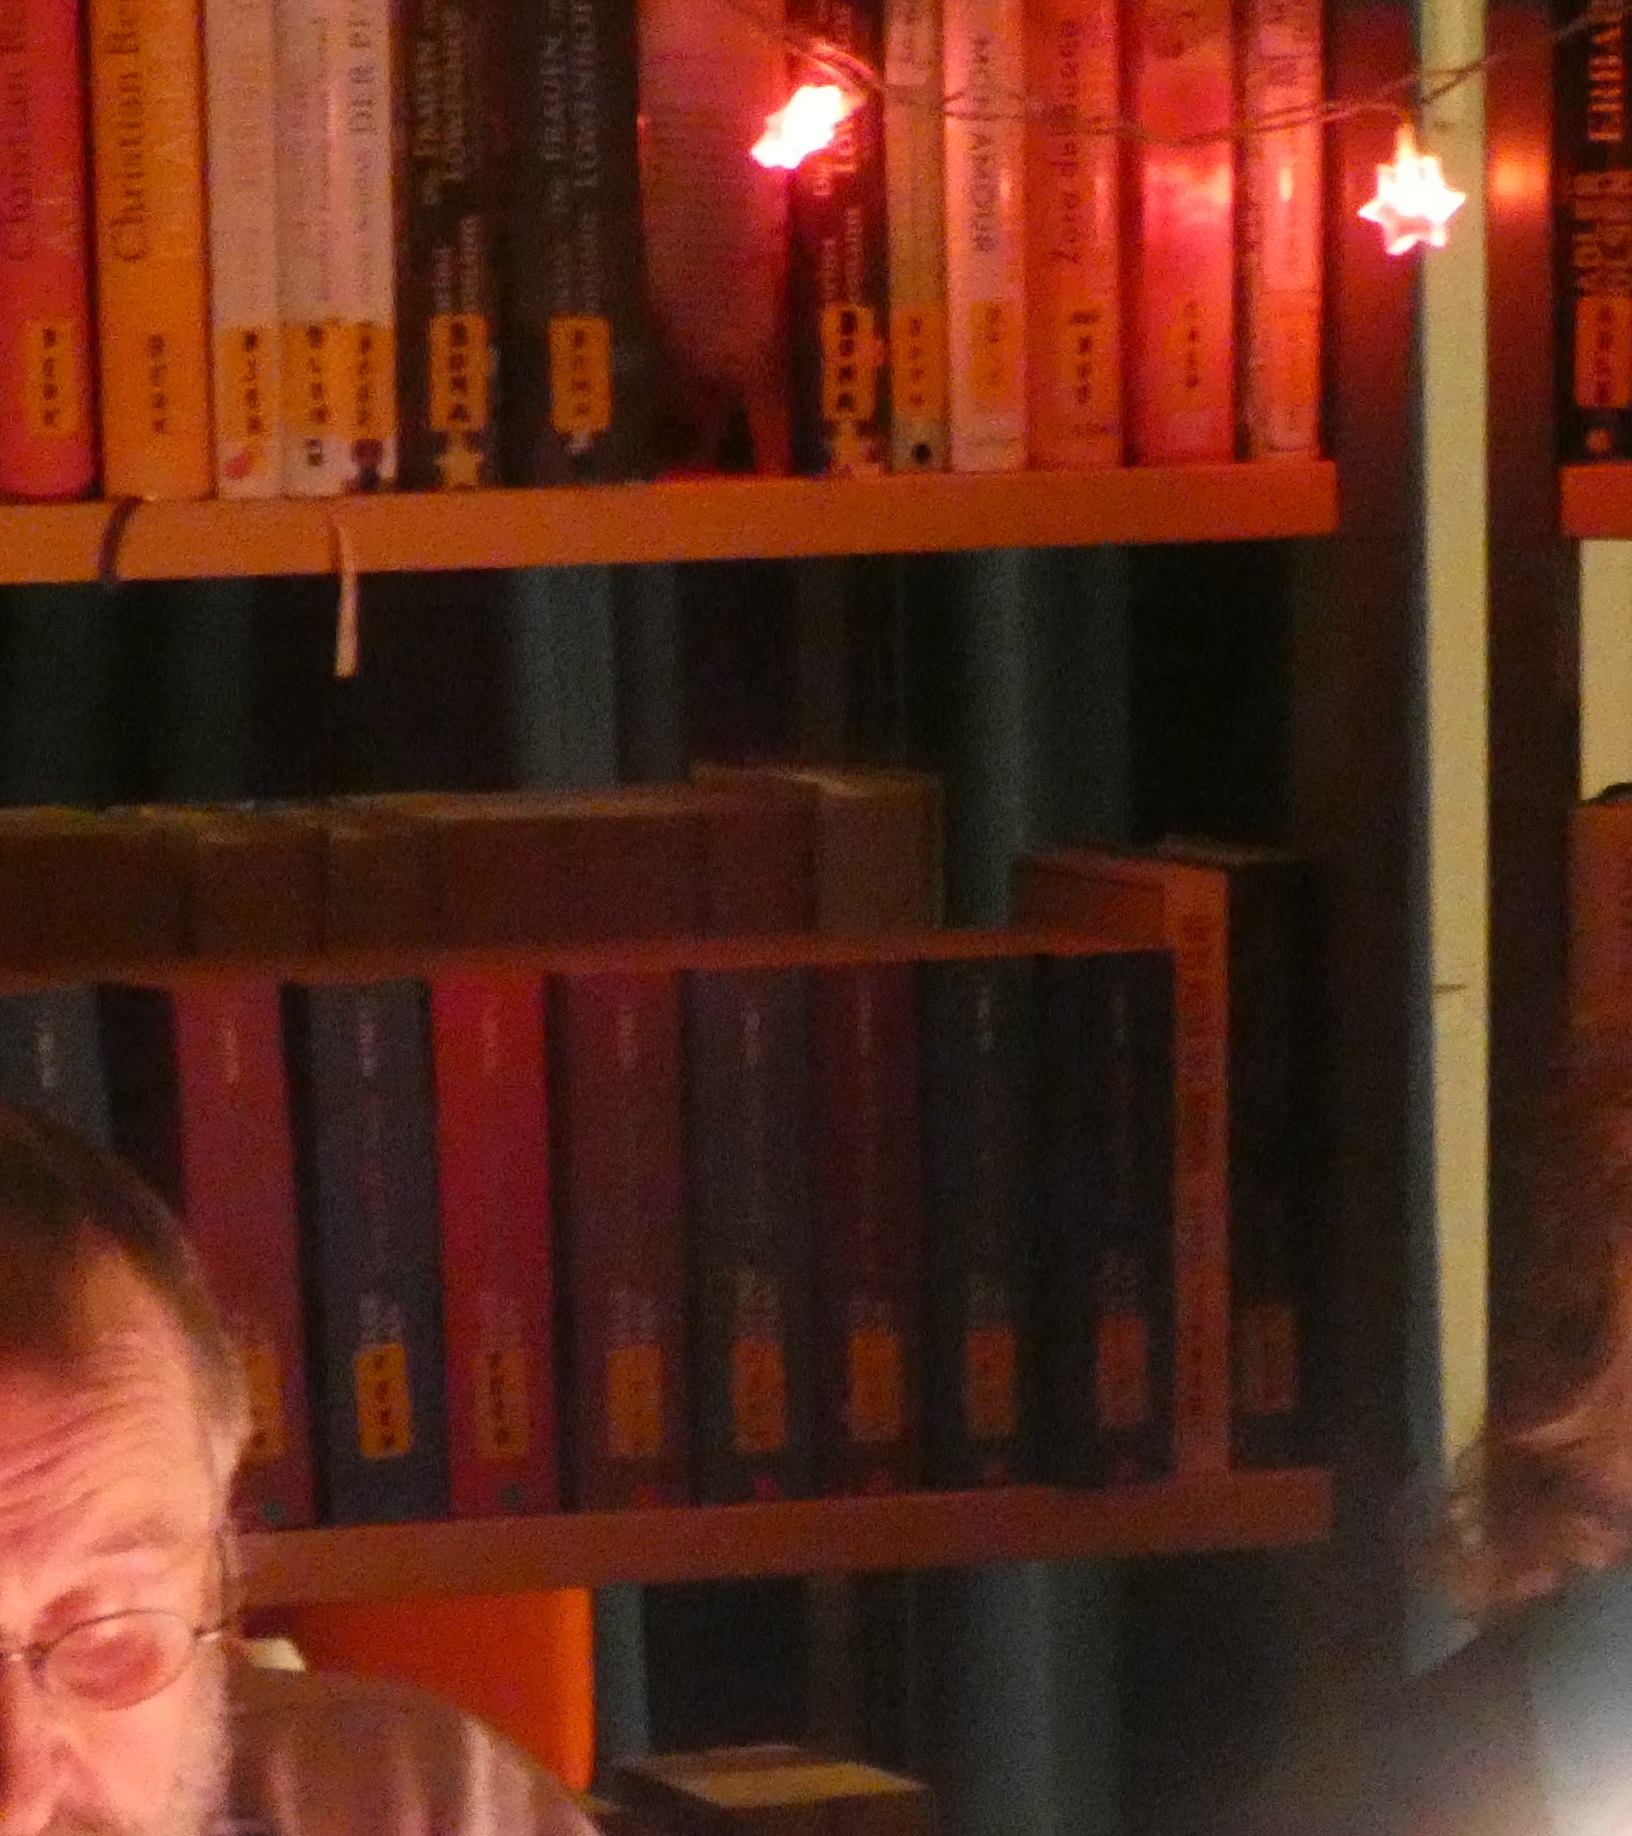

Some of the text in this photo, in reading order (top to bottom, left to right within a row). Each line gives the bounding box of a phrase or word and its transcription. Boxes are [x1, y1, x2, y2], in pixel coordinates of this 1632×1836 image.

[541, 34, 565, 163] FRAUEN
[110, 71, 151, 265] Christian
[971, 132, 996, 253] AMOUR
